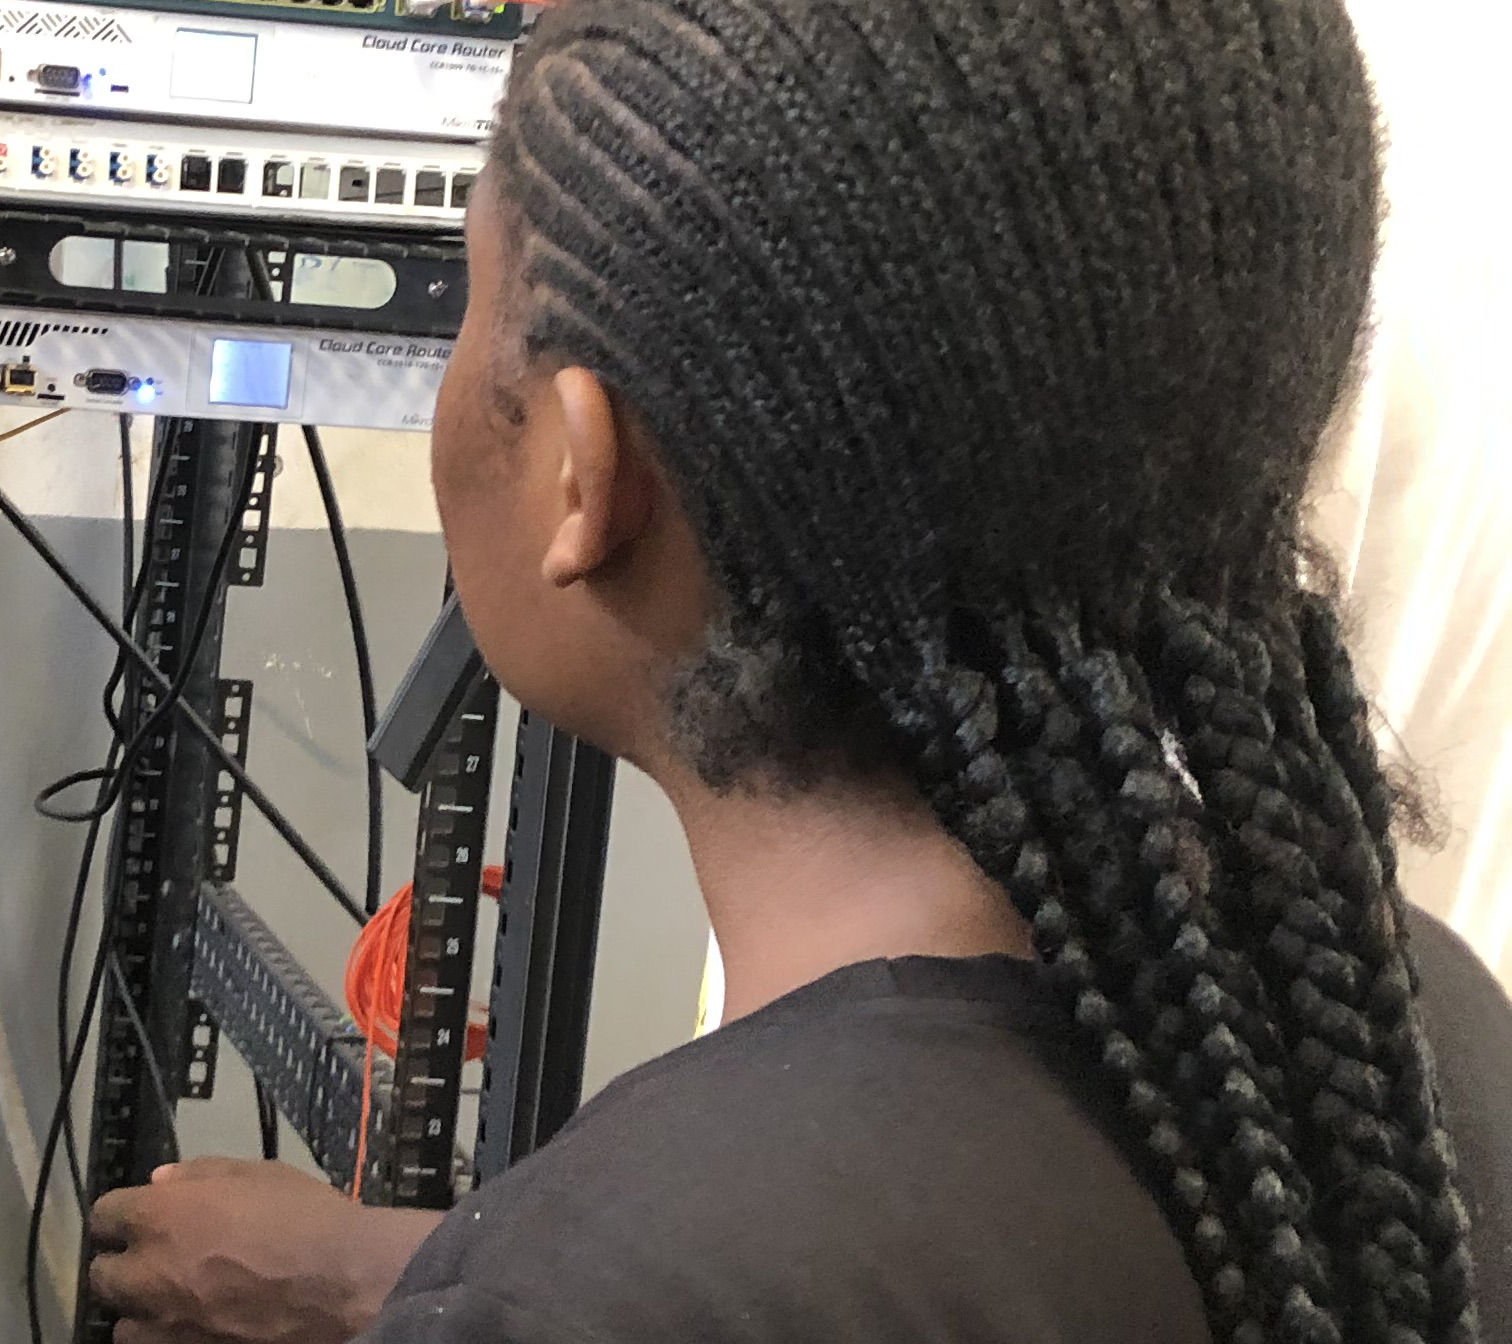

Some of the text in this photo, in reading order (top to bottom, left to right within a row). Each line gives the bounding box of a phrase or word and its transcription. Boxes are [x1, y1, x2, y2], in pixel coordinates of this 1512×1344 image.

[362, 35, 506, 58] Cloud Core Router
[319, 338, 452, 359] Cloud Core Route
[465, 754, 480, 773] 27
